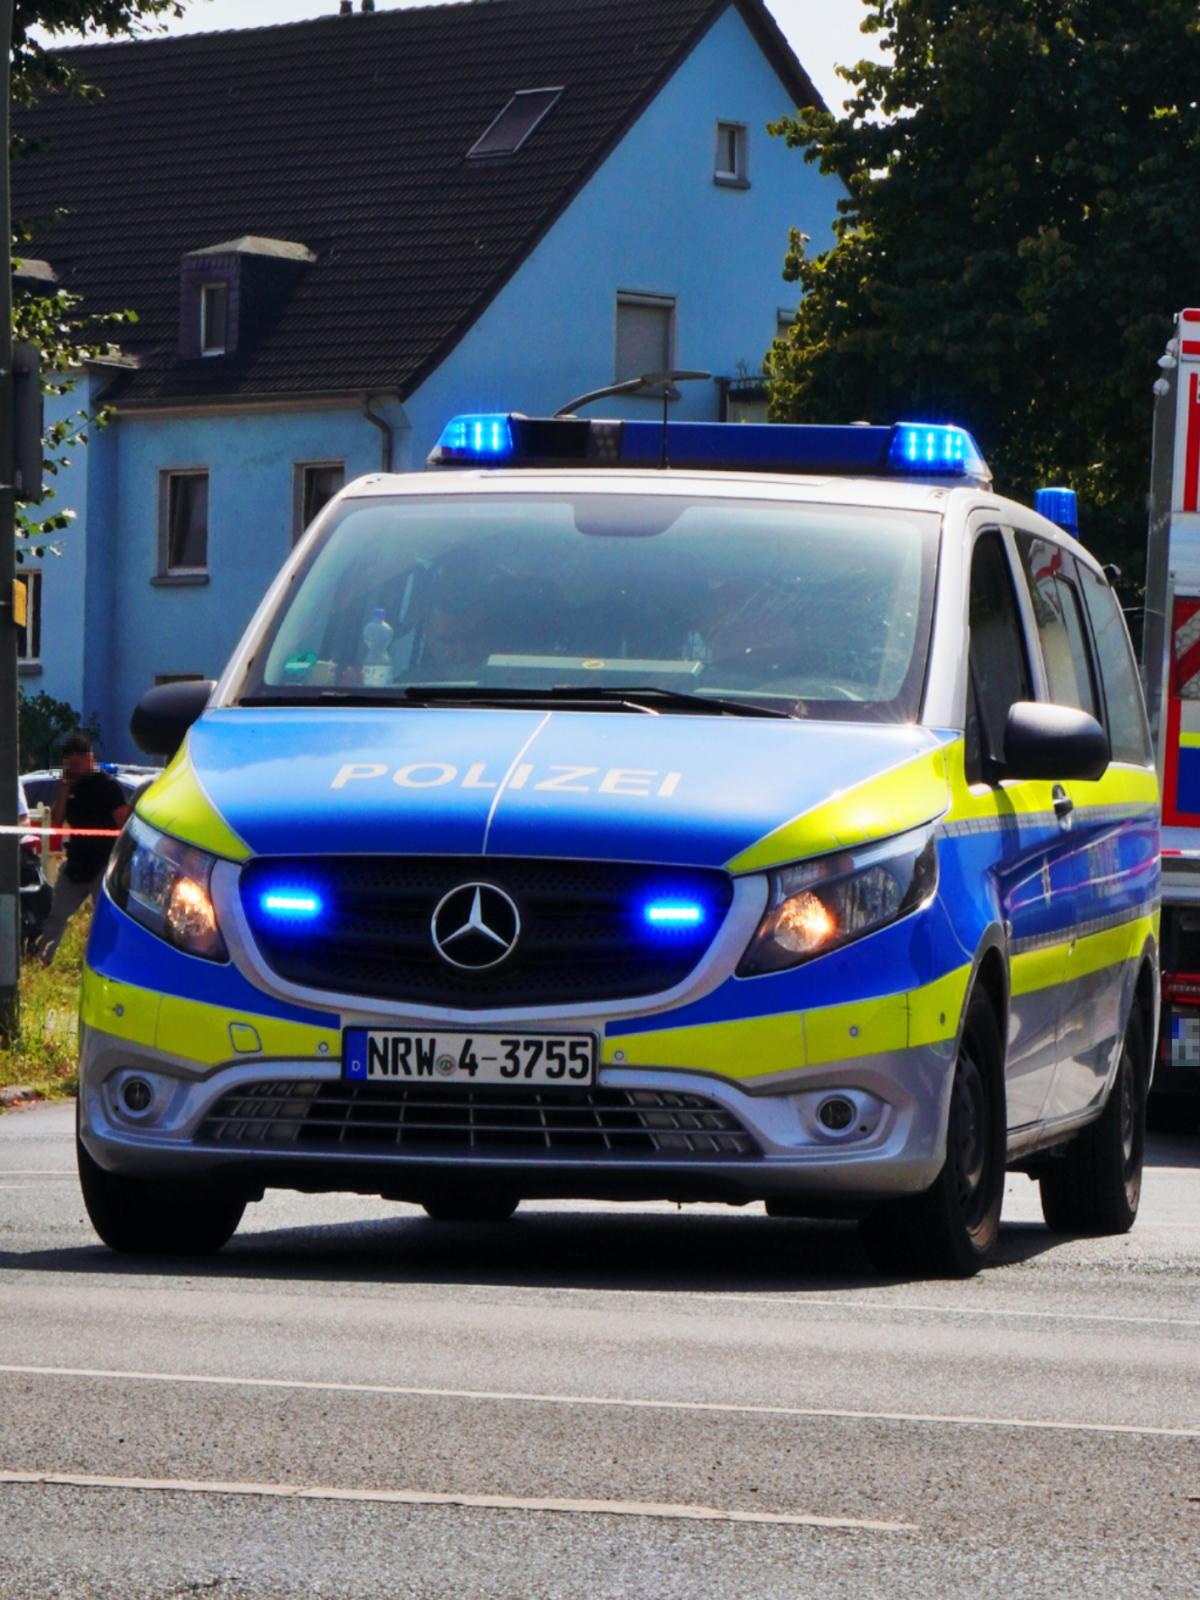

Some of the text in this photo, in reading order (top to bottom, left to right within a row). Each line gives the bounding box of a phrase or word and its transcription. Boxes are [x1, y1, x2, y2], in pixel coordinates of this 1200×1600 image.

[330, 762, 682, 797] POLIZEI
[351, 1036, 589, 1079] D NRW 4-3755
